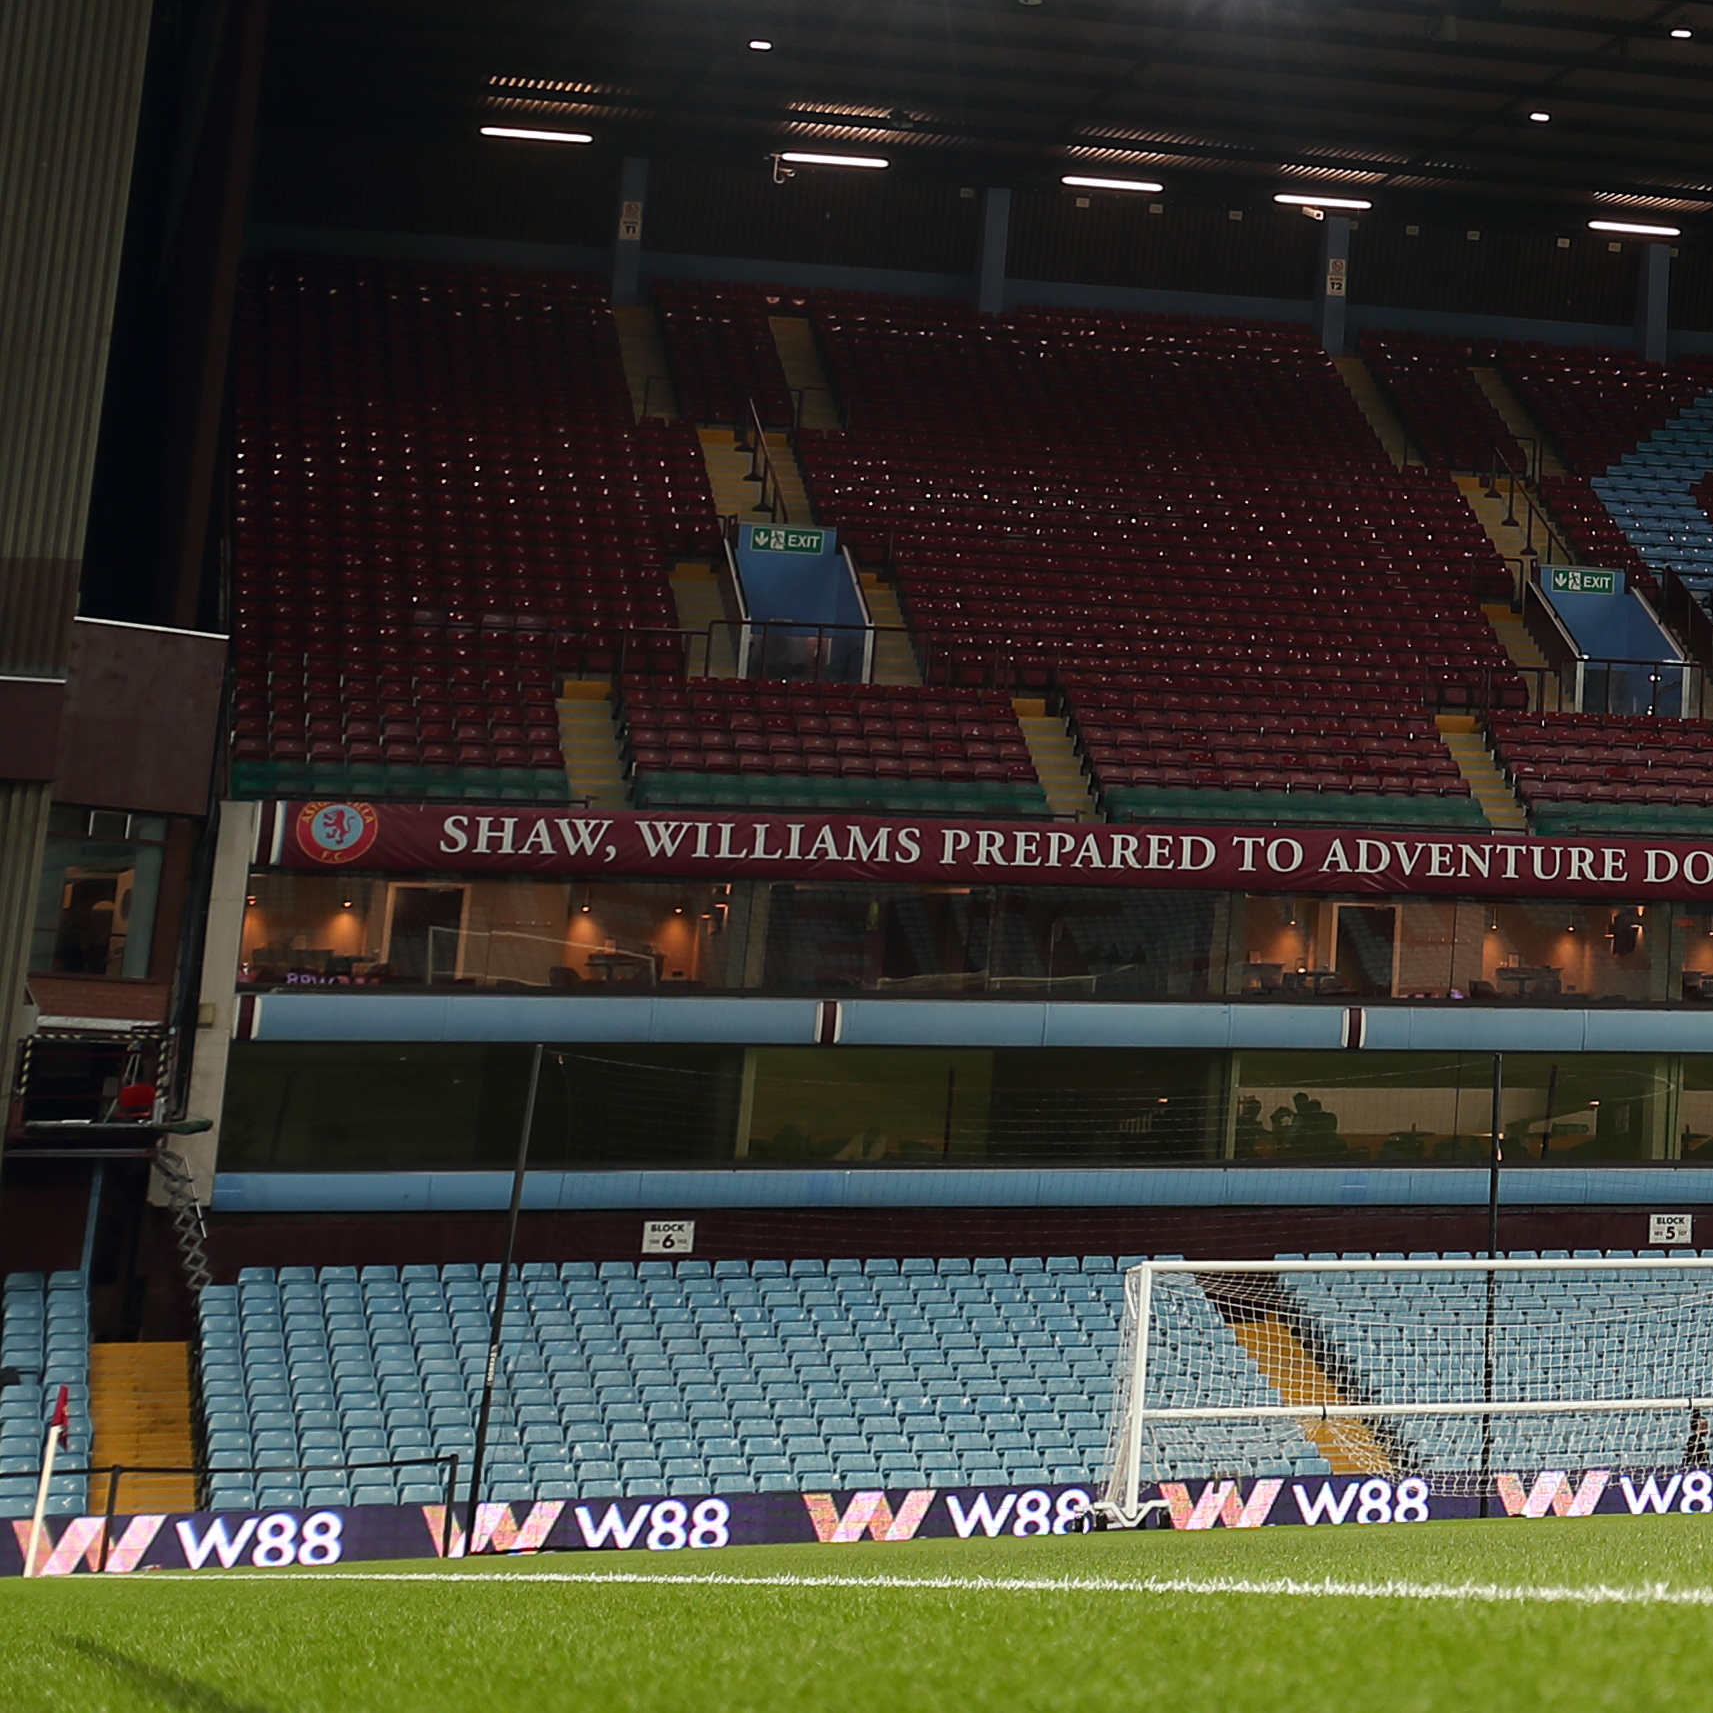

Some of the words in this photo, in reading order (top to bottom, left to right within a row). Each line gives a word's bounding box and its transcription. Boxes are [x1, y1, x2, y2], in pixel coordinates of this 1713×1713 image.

[788, 535, 820, 548] EXIT
[1583, 576, 1611, 589] EXIT
[440, 816, 616, 861] SHAW,
[635, 821, 920, 863] WILLIAMS
[940, 830, 1215, 869] PREPARED
[1233, 837, 1302, 872] TO
[1319, 839, 1627, 881] ADVENTURE
[650, 1224, 686, 1233] BLOCK
[1656, 1217, 1685, 1225] BLOCK
[662, 1233, 675, 1249] 6
[1665, 1226, 1676, 1241] 5
[1293, 1477, 1428, 1525] W88
[574, 1497, 730, 1550] W88
[176, 1510, 343, 1571] W88
